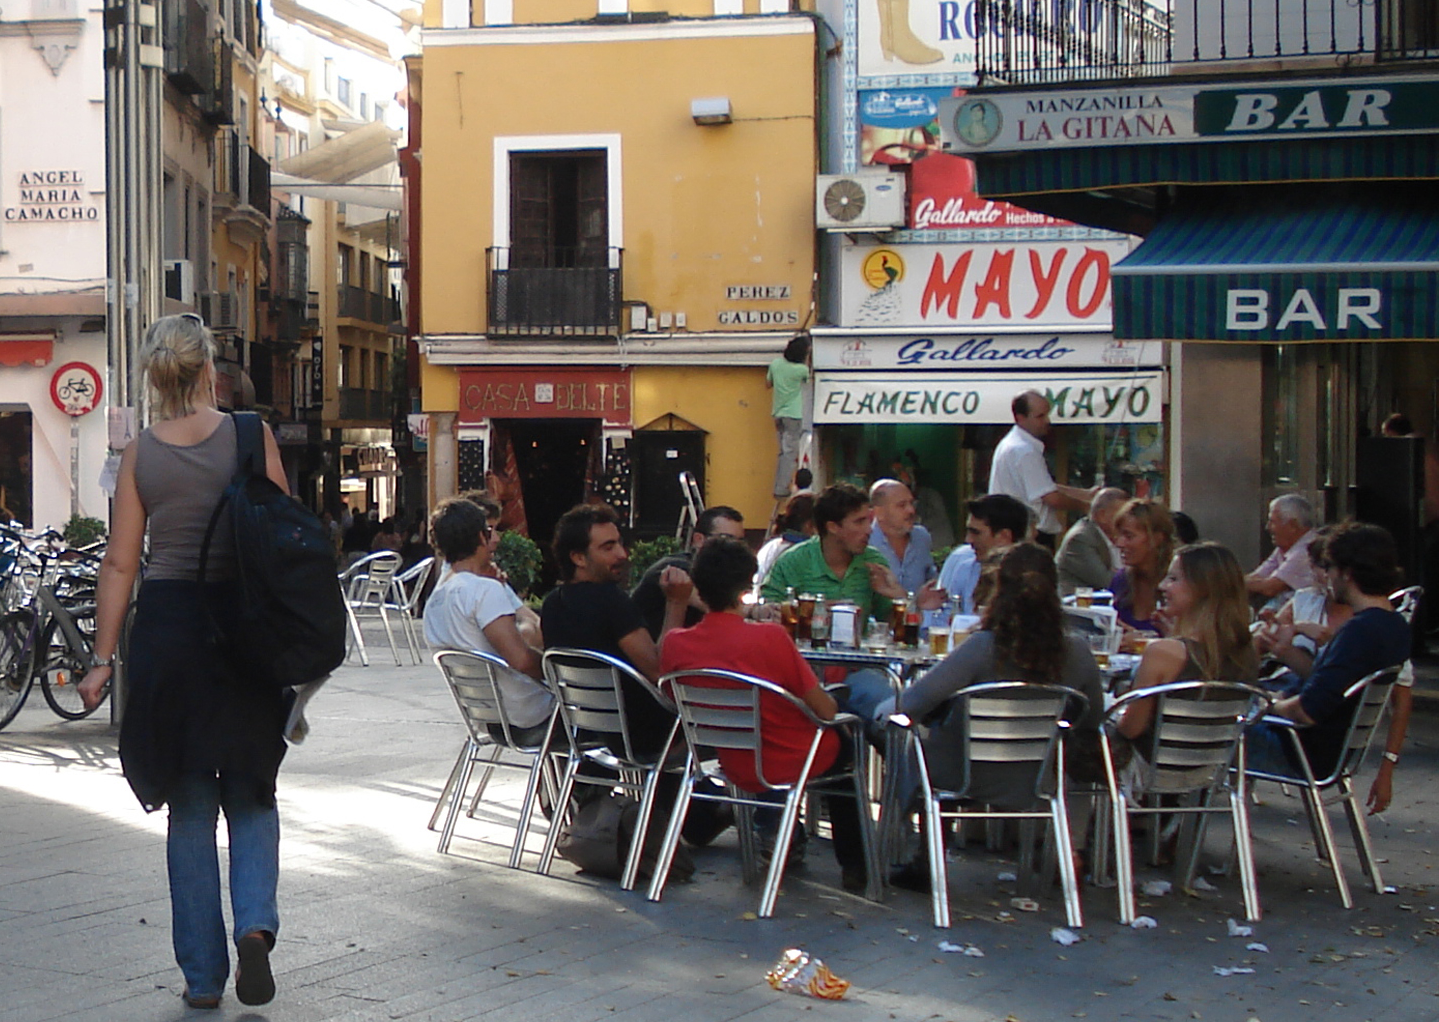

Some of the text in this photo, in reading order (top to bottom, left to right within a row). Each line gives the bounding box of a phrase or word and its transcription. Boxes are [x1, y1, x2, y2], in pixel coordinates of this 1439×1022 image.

[1026, 95, 1163, 113] MANZANILLA
[1224, 89, 1391, 131] BAR
[1017, 114, 1176, 142] LA GITANA
[20, 171, 83, 185] ANGEL
[21, 189, 81, 202] MARIA
[5, 208, 98, 220] CAMACHO
[915, 198, 1002, 229] Gallardo
[1006, 206, 1044, 224] Hechos
[727, 286, 789, 298] PEREZ
[920, 246, 1111, 320] MAYO
[718, 312, 798, 324] GALDOS
[1226, 288, 1382, 330] BAR
[897, 336, 1075, 364] Gallardo
[465, 382, 530, 412] CASA
[824, 386, 1151, 419] FLAMENCO MAYO
